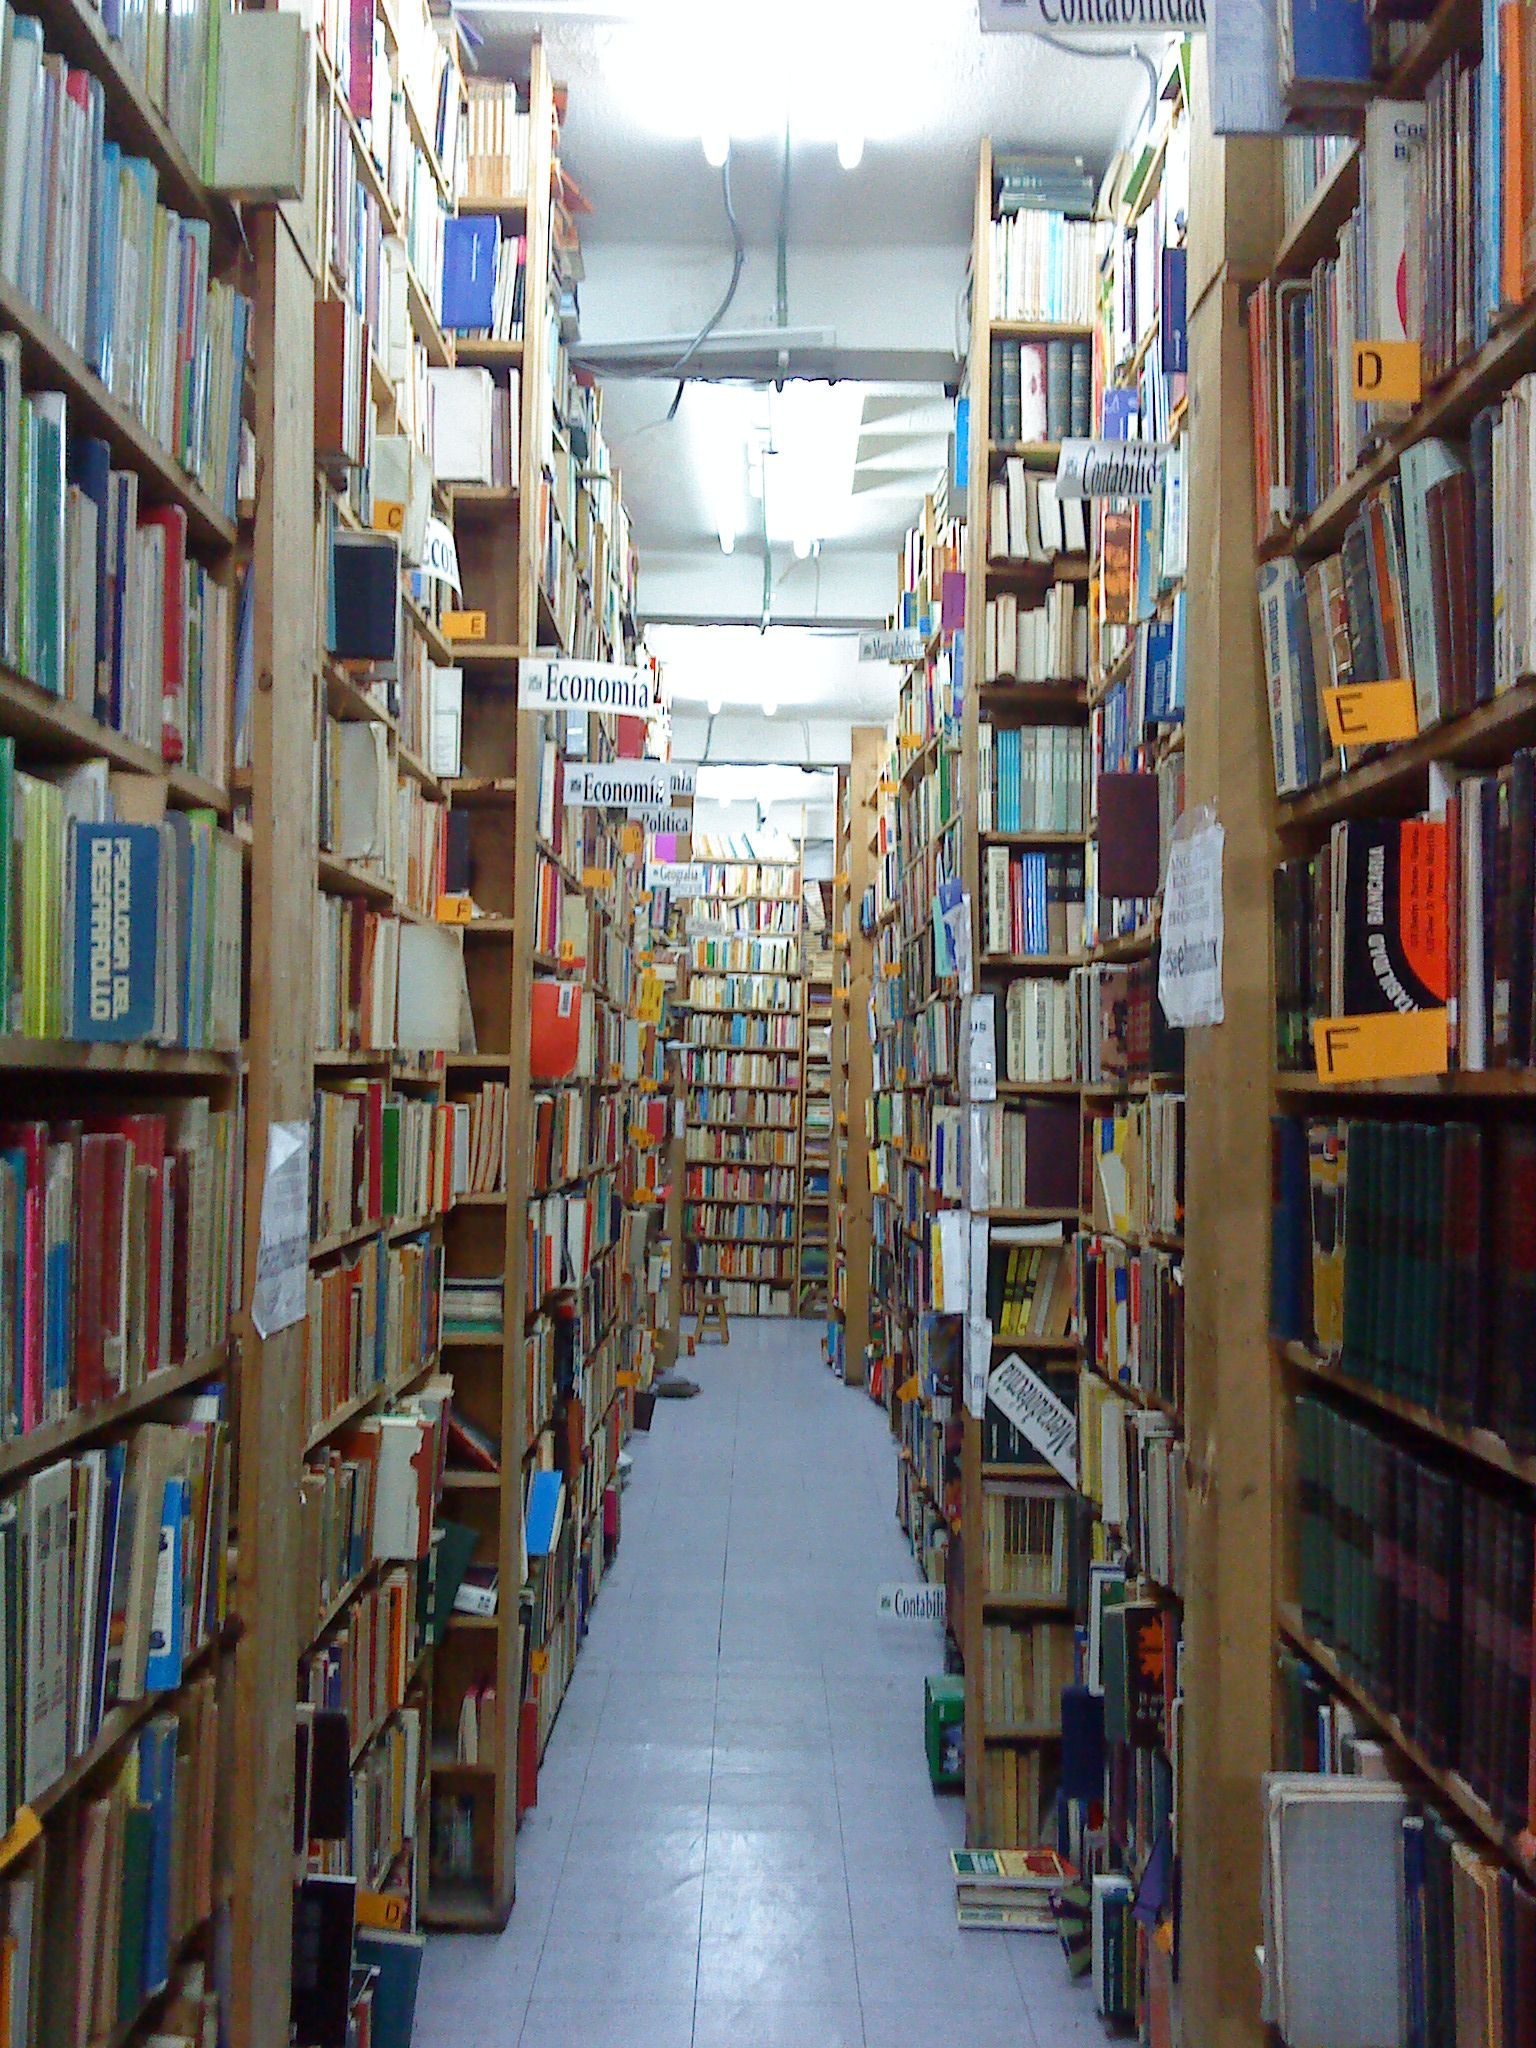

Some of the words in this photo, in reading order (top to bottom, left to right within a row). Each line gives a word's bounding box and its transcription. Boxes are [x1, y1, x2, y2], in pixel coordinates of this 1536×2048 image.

[1358, 351, 1382, 389] D
[388, 507, 401, 528] C
[471, 615, 482, 635] E
[546, 662, 649, 709] Economía
[1336, 691, 1368, 734] E
[584, 773, 665, 802] Economía
[456, 901, 468, 918] F
[90, 837, 113, 1022] DESARROLLO
[1325, 1026, 1361, 1073] F
